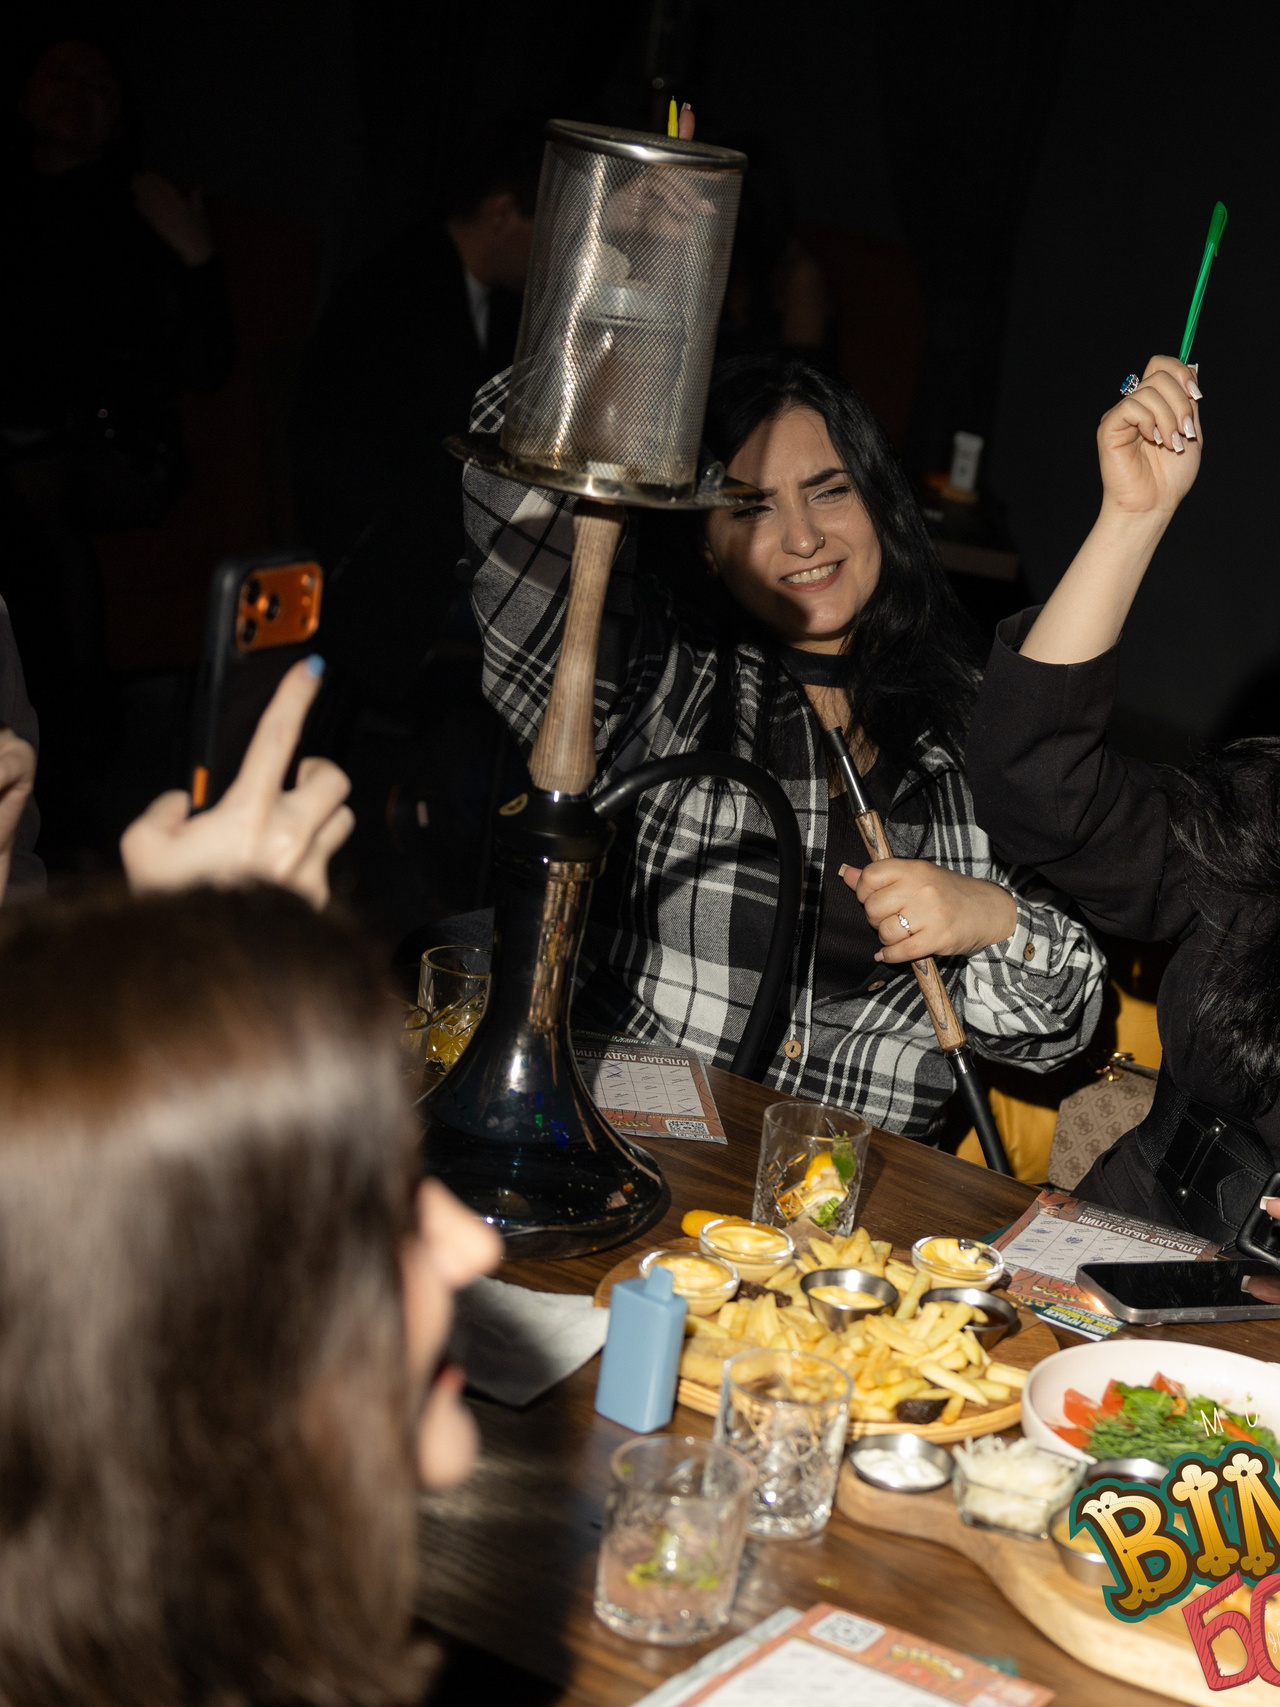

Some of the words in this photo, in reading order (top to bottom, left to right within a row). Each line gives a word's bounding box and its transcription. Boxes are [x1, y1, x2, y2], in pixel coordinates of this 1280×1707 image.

[575, 1051, 637, 1061] АБДУЛЛИ
[640, 1056, 690, 1066] ИЛЬДАР
[1076, 1214, 1149, 1240] АБДУЛЛИН
[1150, 1236, 1202, 1253] ИЛЬДАР
